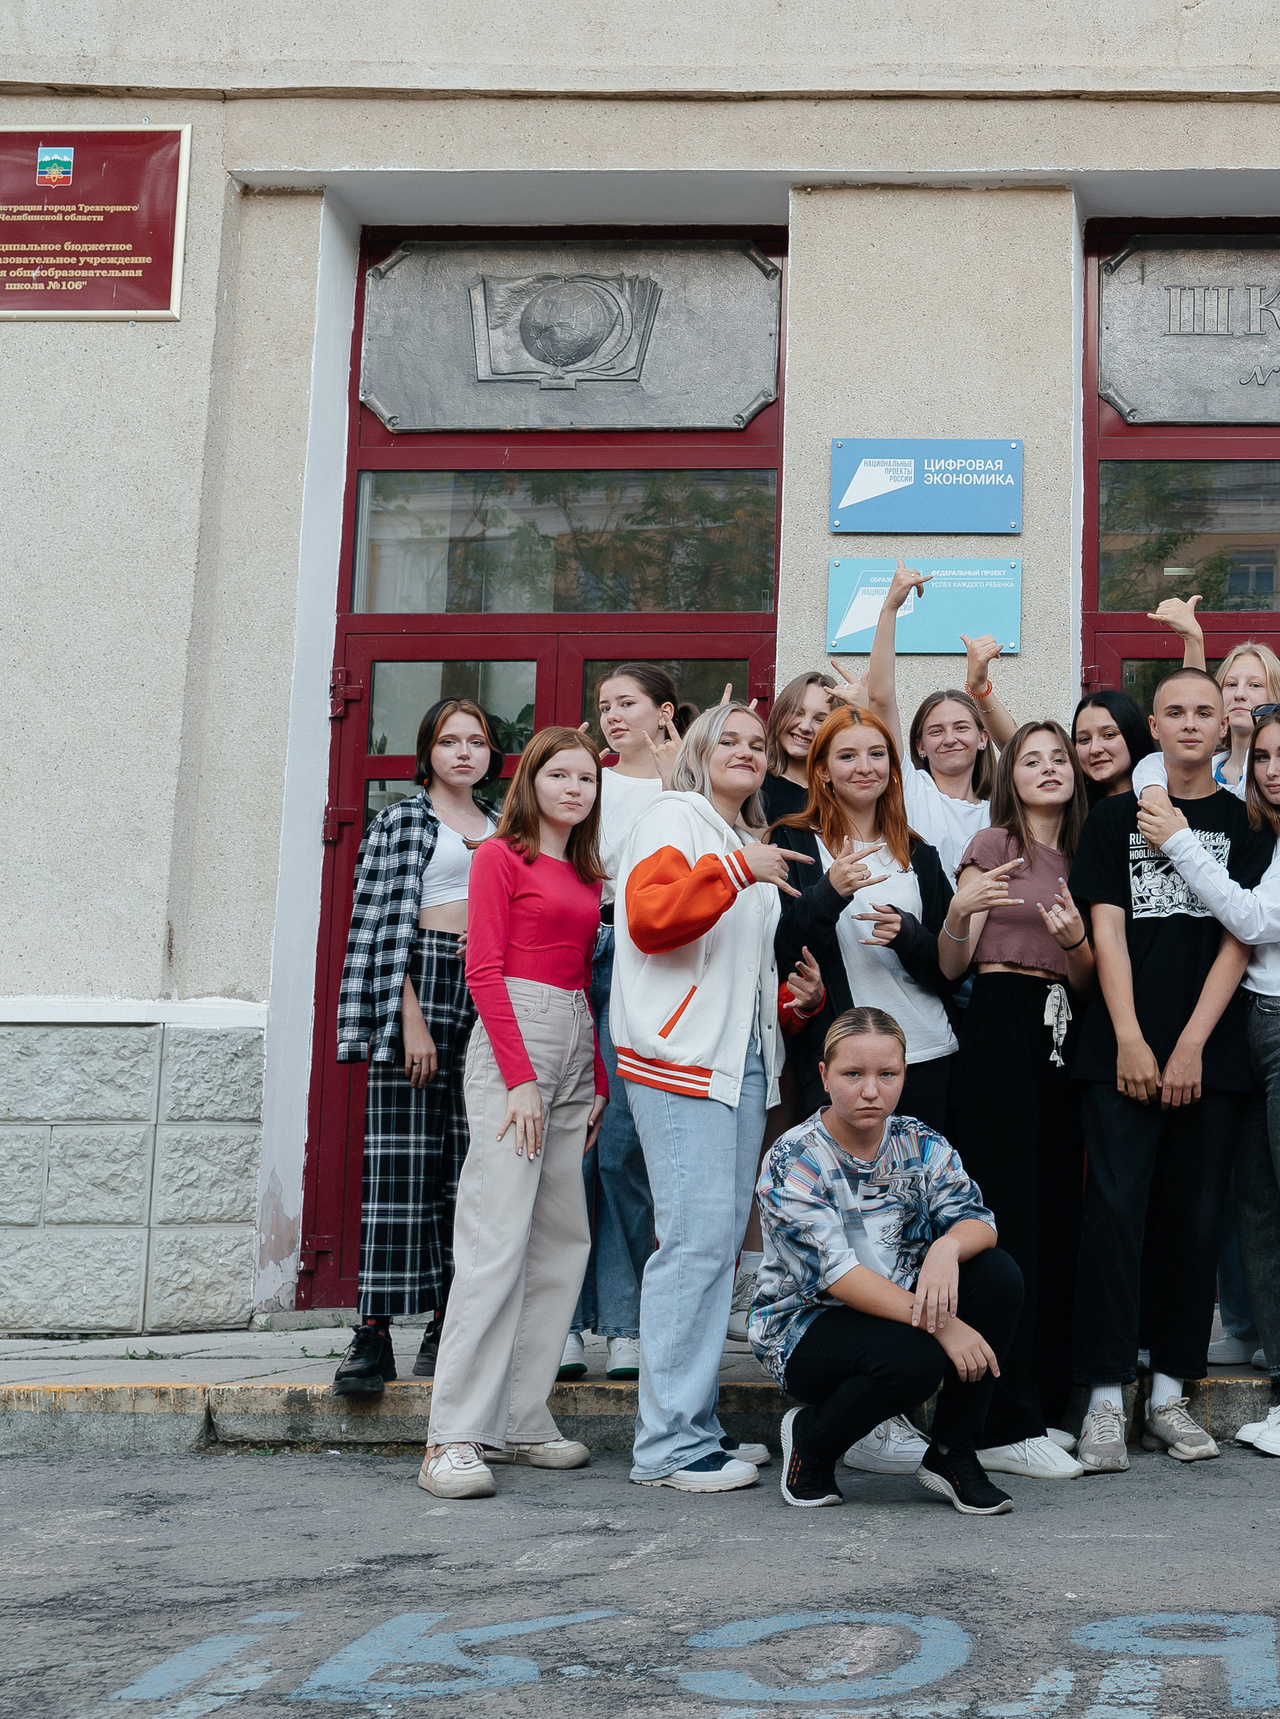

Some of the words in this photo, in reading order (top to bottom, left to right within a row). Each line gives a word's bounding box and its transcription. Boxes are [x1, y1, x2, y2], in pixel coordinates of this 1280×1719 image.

[44, 204, 76, 212] города
[78, 204, 138, 213] Трехгорного
[0, 213, 63, 221] Челябинской
[64, 213, 104, 221] области
[64, 242, 132, 252] бюджетное
[79, 256, 152, 266] учреждение
[5, 282, 45, 290] школа
[864, 460, 913, 468] НАЦИОНАЛЬНЫЕ
[924, 459, 1003, 472] ЦИФРОВАЯ
[924, 473, 1015, 485] ЭКОНОМИКА
